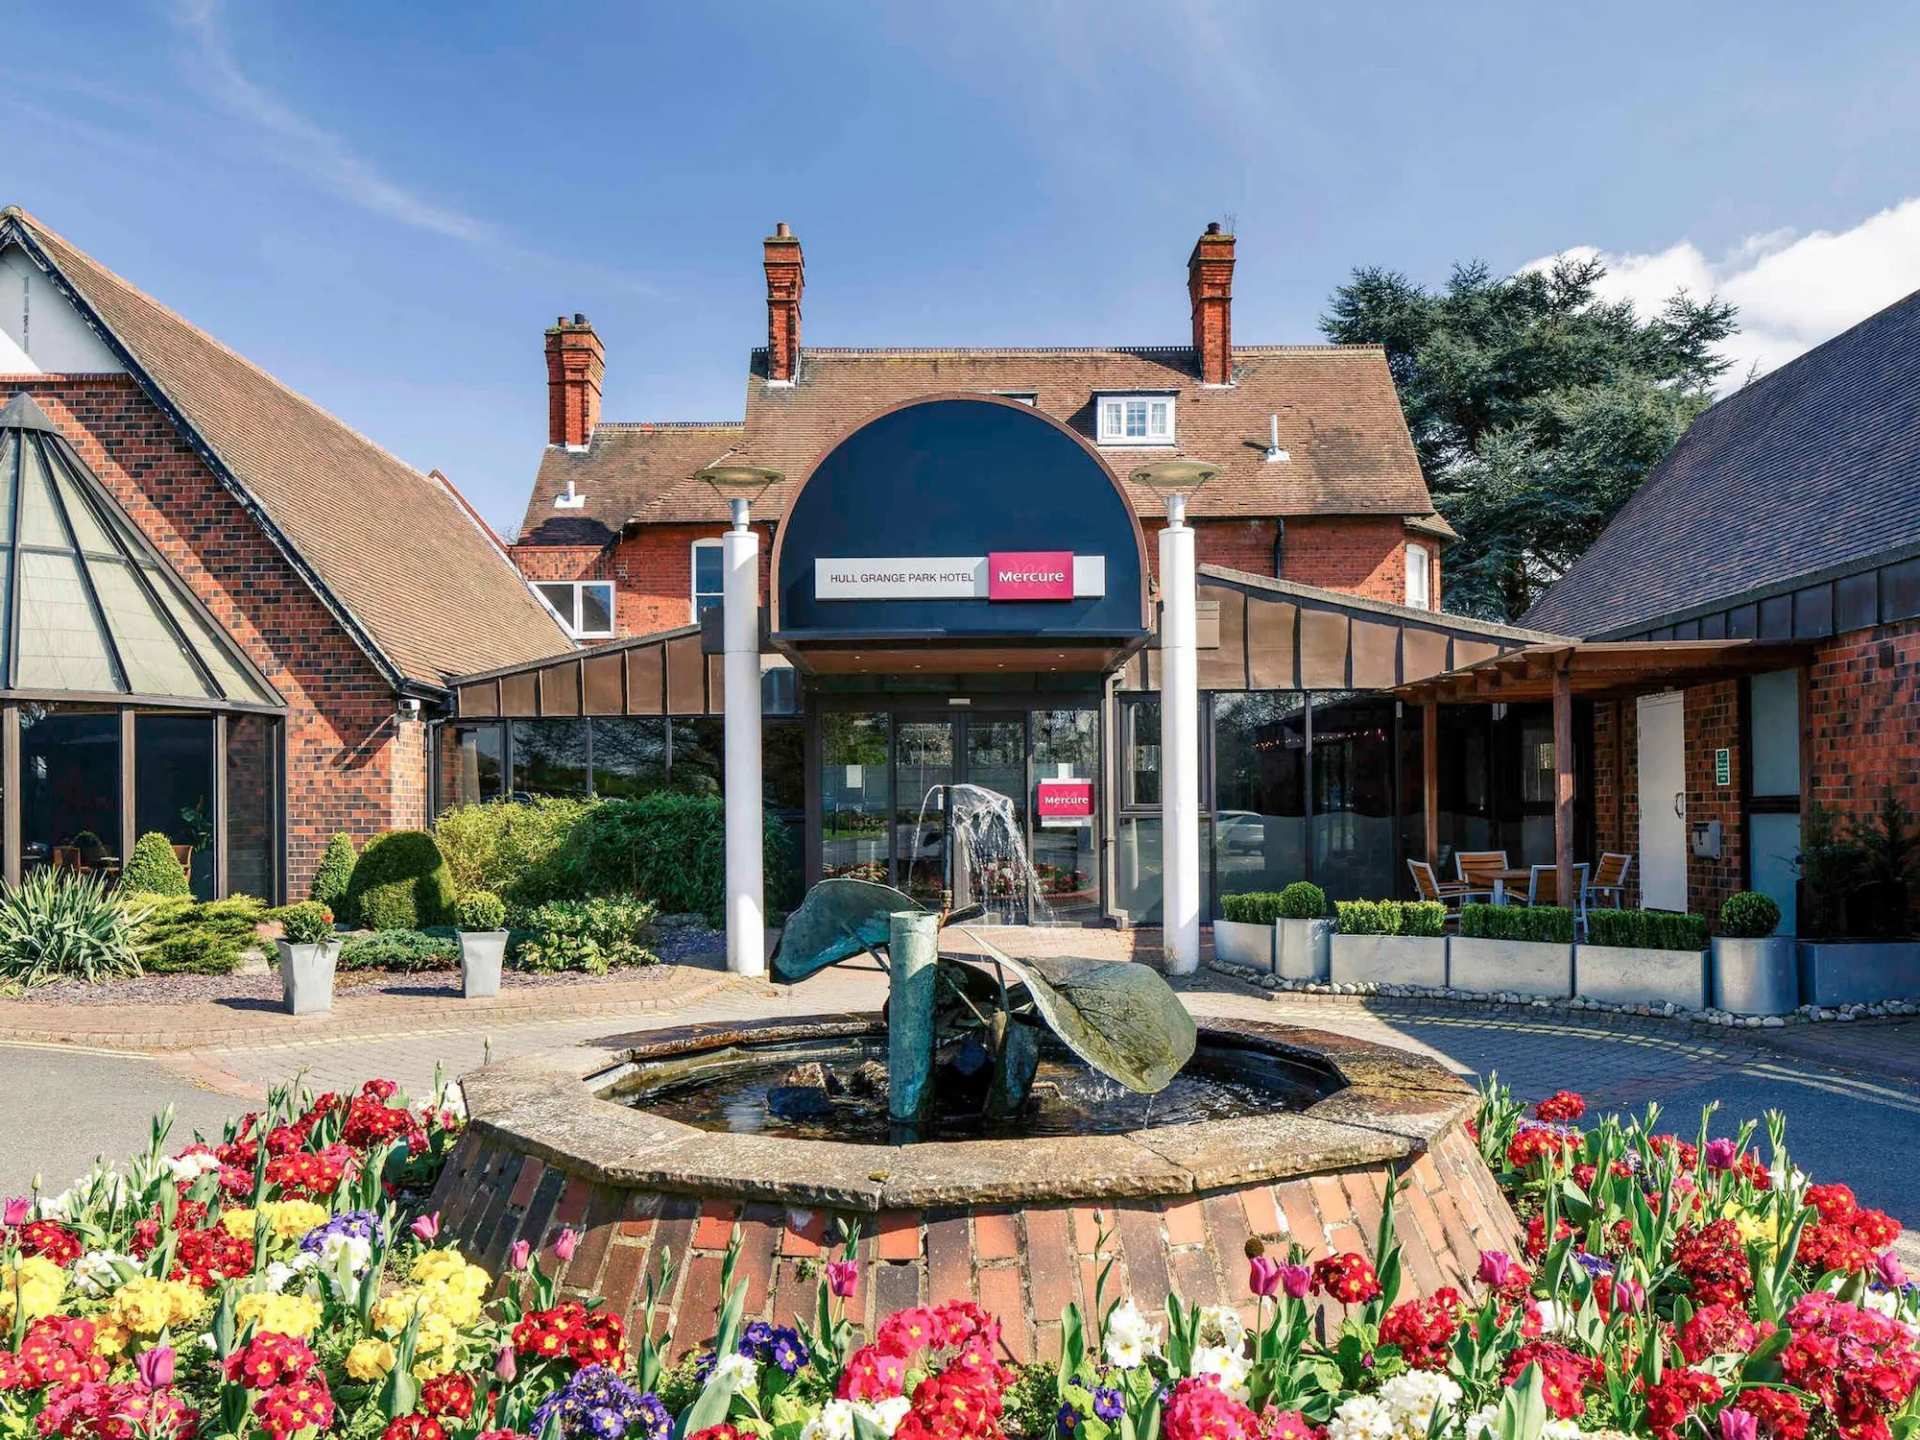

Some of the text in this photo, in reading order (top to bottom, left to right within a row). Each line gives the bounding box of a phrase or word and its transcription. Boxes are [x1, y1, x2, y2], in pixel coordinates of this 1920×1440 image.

[830, 572, 974, 583] HULL GRANGE PARK HOTEL
[999, 571, 1064, 582] Mercure
[1044, 796, 1089, 805] Mercure
